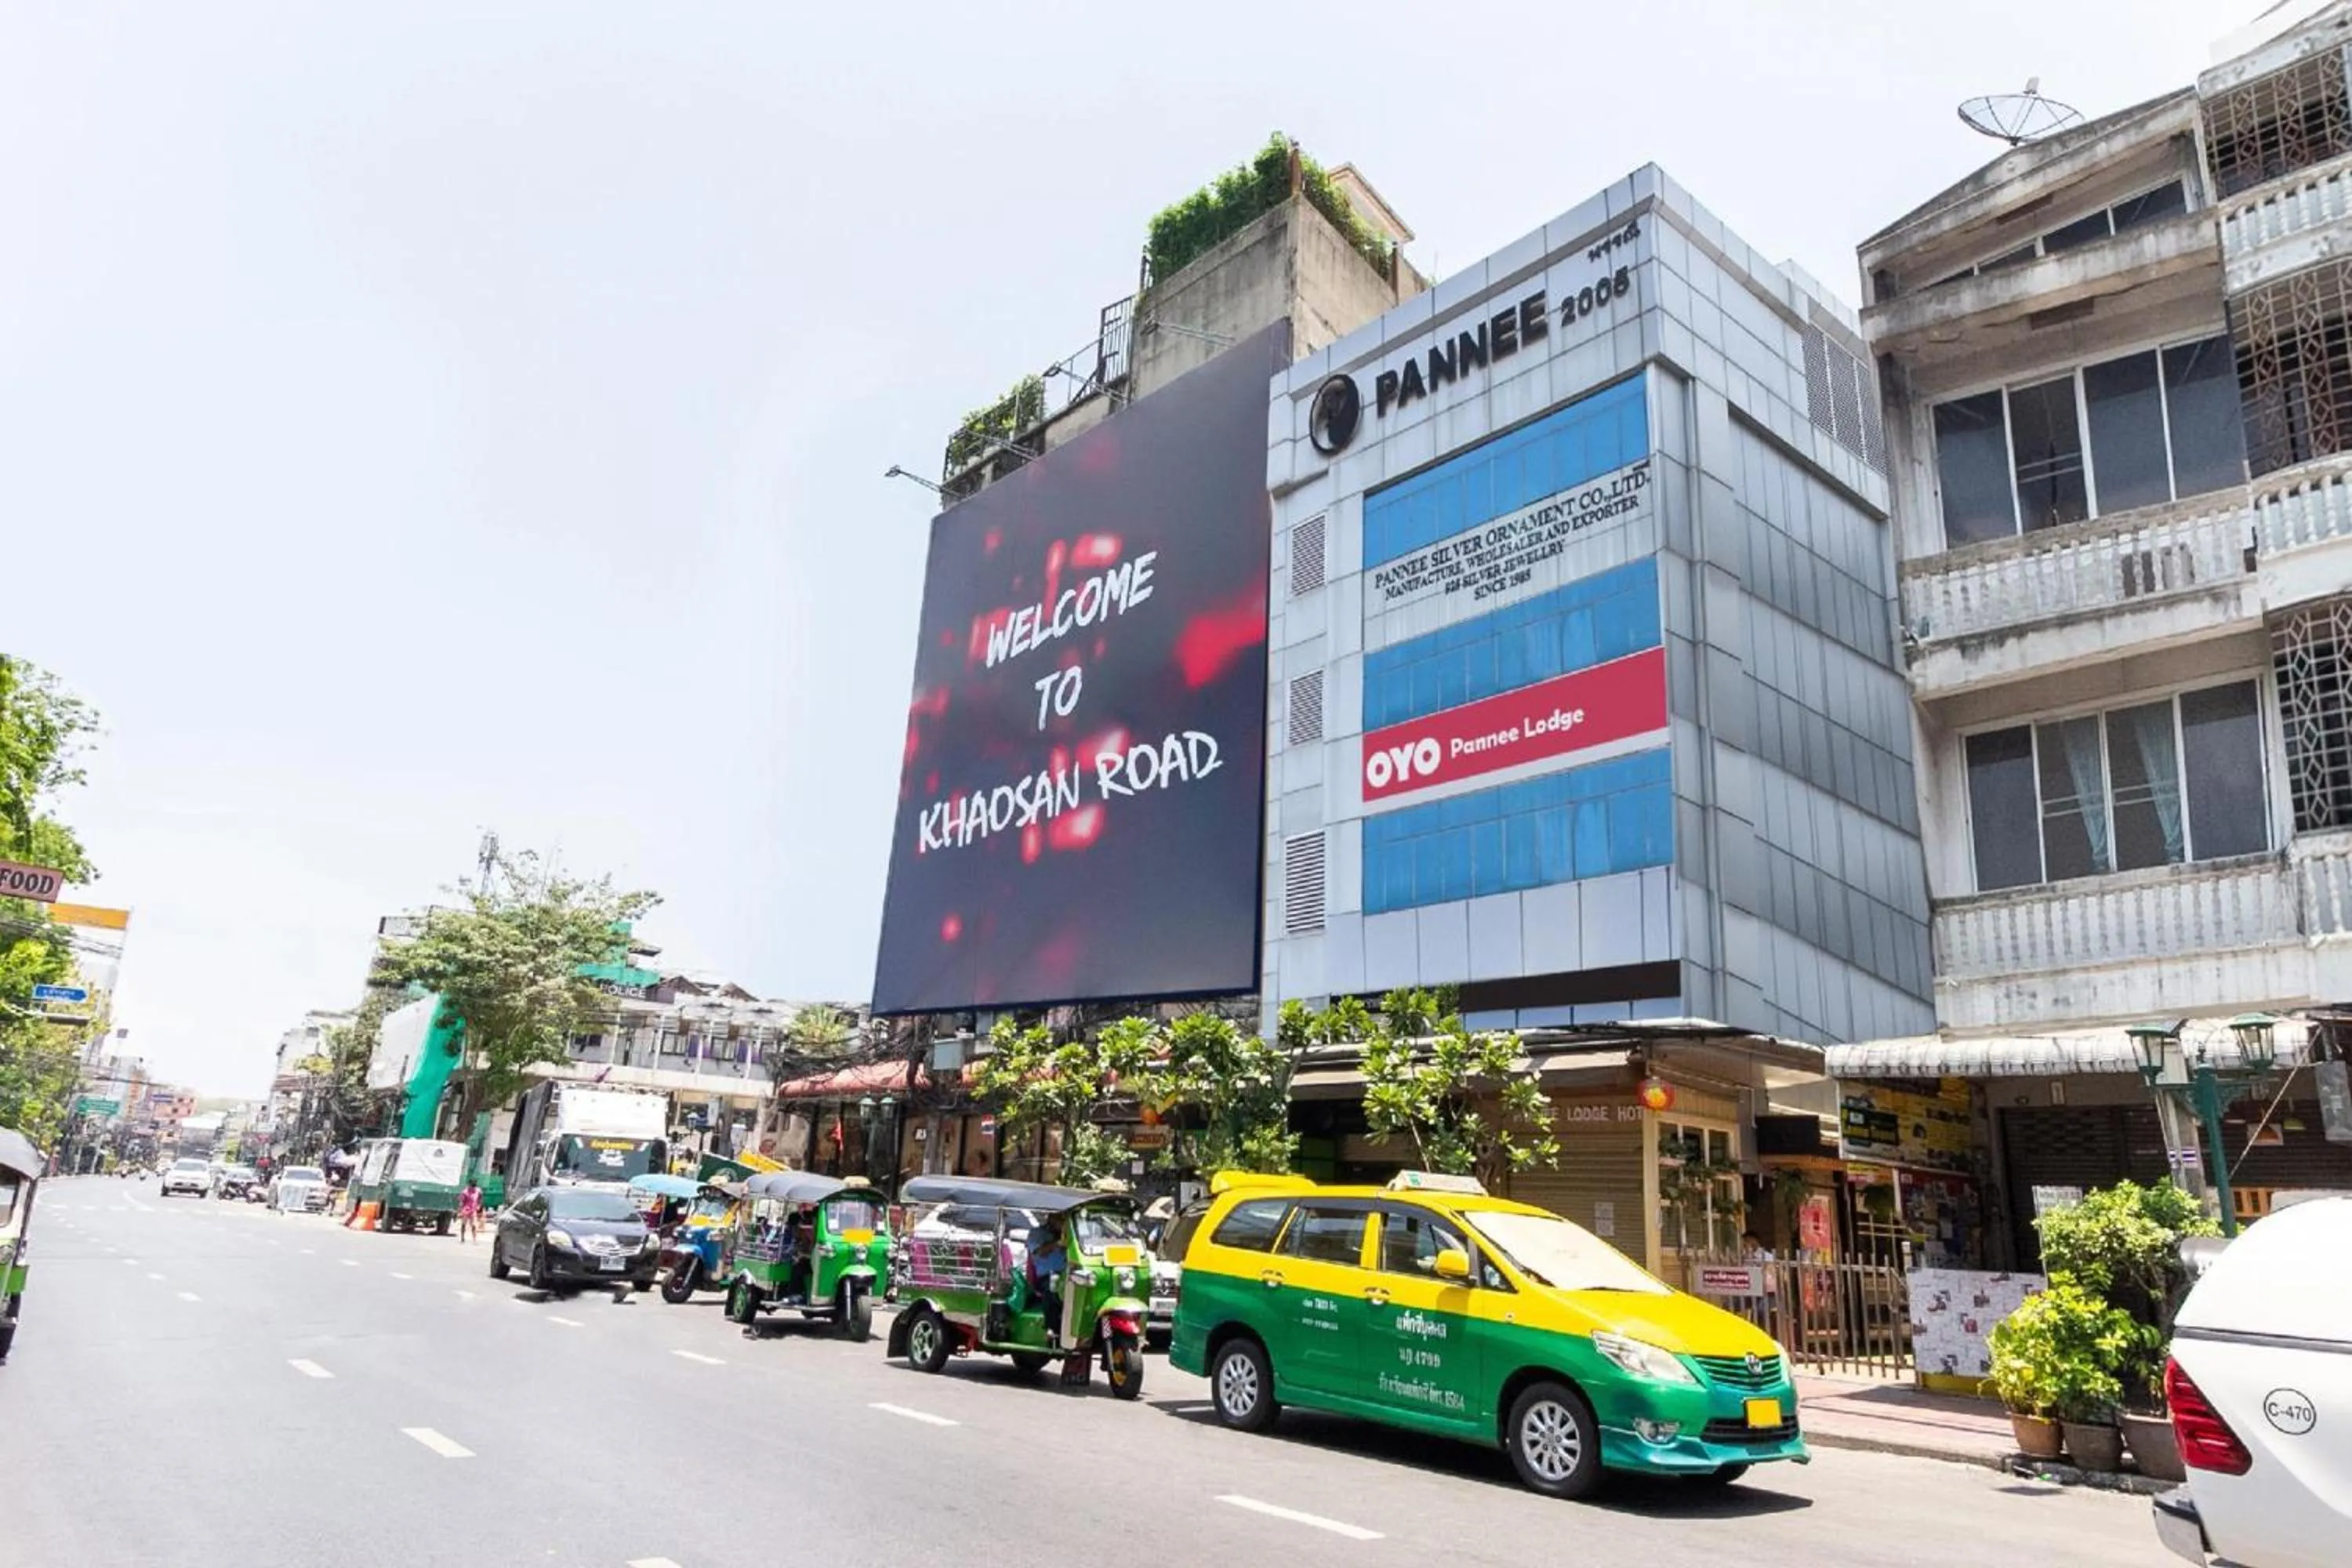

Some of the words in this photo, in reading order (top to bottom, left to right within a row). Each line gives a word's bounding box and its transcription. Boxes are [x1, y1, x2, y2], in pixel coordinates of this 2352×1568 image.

[1376, 289, 1549, 419] PANNEE
[1375, 555, 1428, 589] PANNEE
[1431, 535, 1483, 567] SILVER
[1486, 495, 1576, 546] ORNAMENT
[1467, 531, 1544, 568] WHOLESALER
[1544, 521, 1570, 539] AND
[1572, 495, 1639, 531] EXPORTER
[985, 551, 1158, 668] WELCOME
[1462, 564, 1501, 588] SILVER
[1474, 576, 1507, 601] SINCE
[1035, 665, 1082, 731] TO
[1367, 738, 1441, 788] OYO
[1450, 726, 1519, 758] Pannee
[1523, 709, 1584, 738] Lodge
[919, 761, 1080, 854] KHAOSAN
[1095, 730, 1223, 799] ROAD
[0, 868, 55, 895] FOOD
[1567, 1105, 1610, 1121] LODGE
[1617, 1105, 1643, 1122] HOT
[2267, 1402, 2313, 1422] C-470
